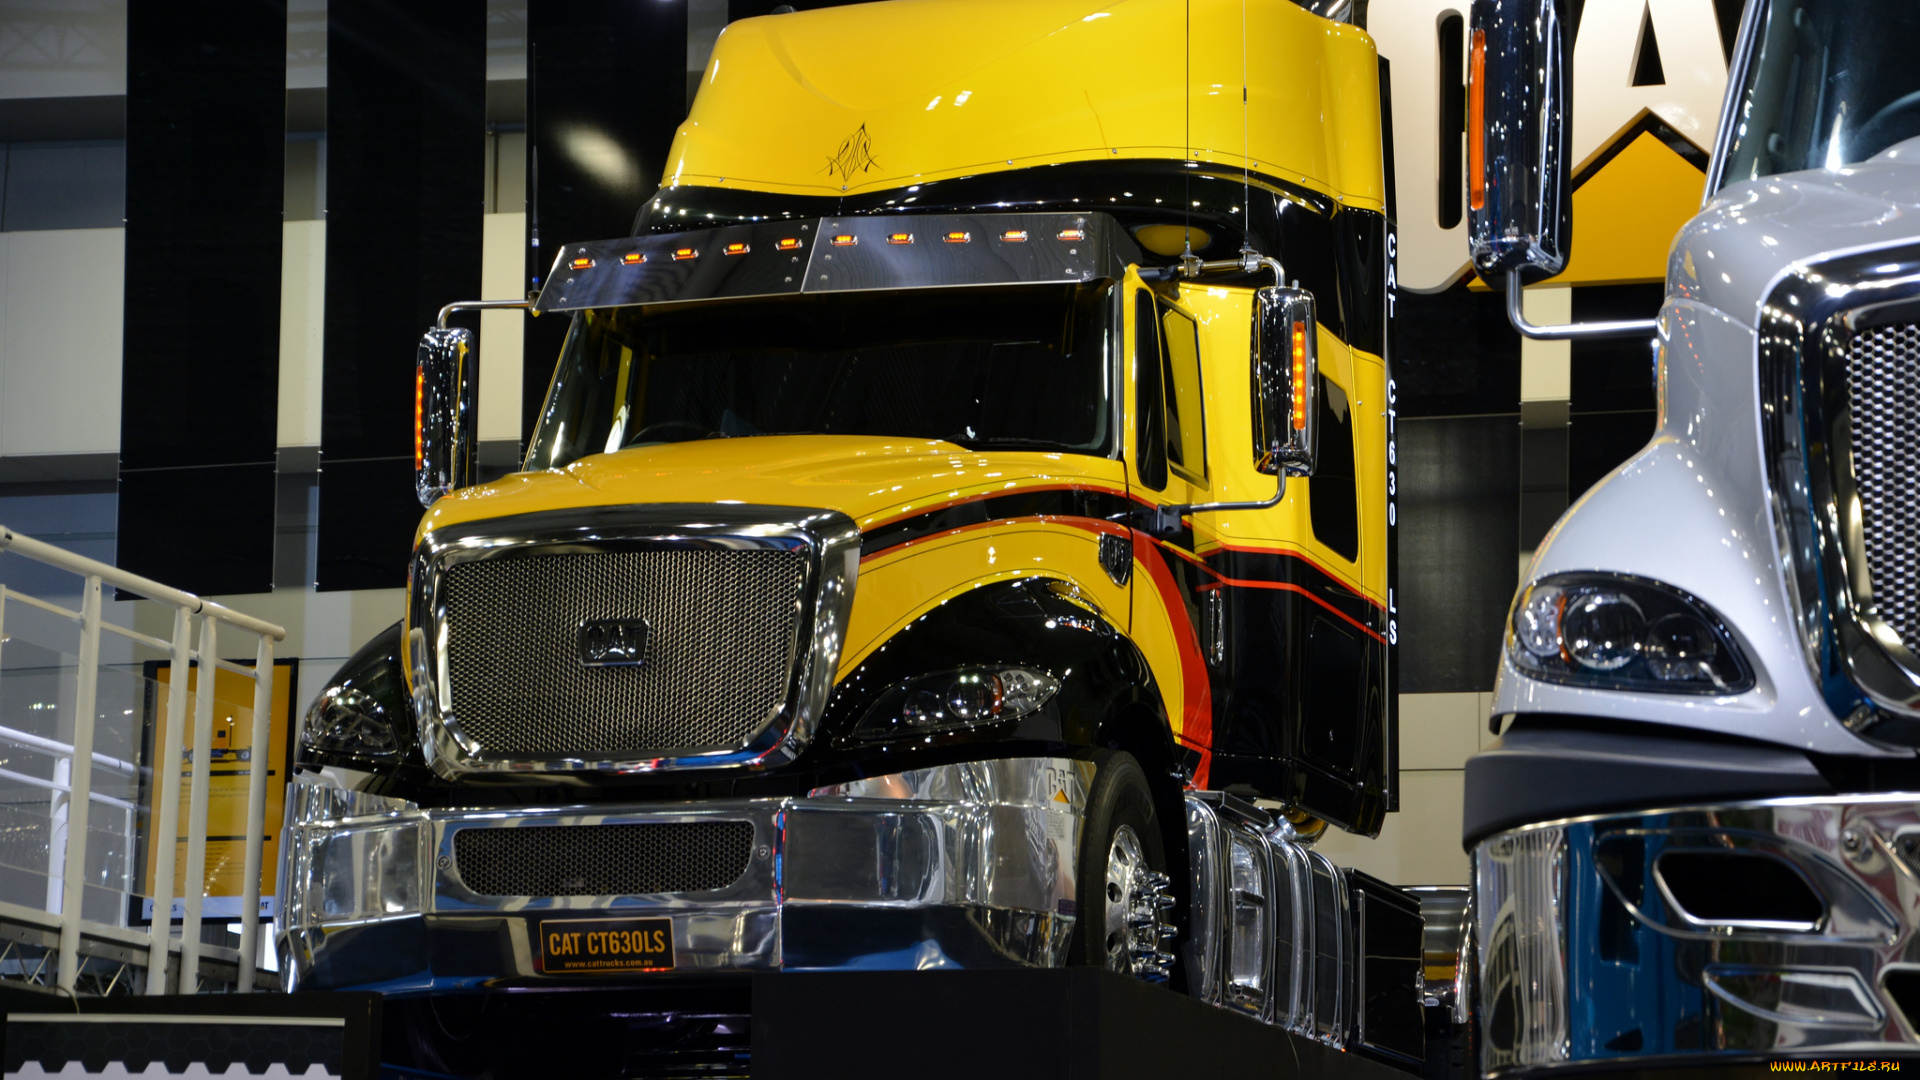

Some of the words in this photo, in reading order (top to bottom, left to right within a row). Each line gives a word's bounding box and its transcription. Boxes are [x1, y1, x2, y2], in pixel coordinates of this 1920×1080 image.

[1387, 232, 1397, 319] CAT
[1387, 379, 1397, 527] CT630
[1388, 588, 1397, 645] LS
[585, 624, 641, 660] CAT
[1046, 767, 1076, 807] CAT
[549, 932, 581, 956] CAT
[587, 929, 666, 955] CT630LS
[564, 959, 654, 968] www.cattrucks.com.au
